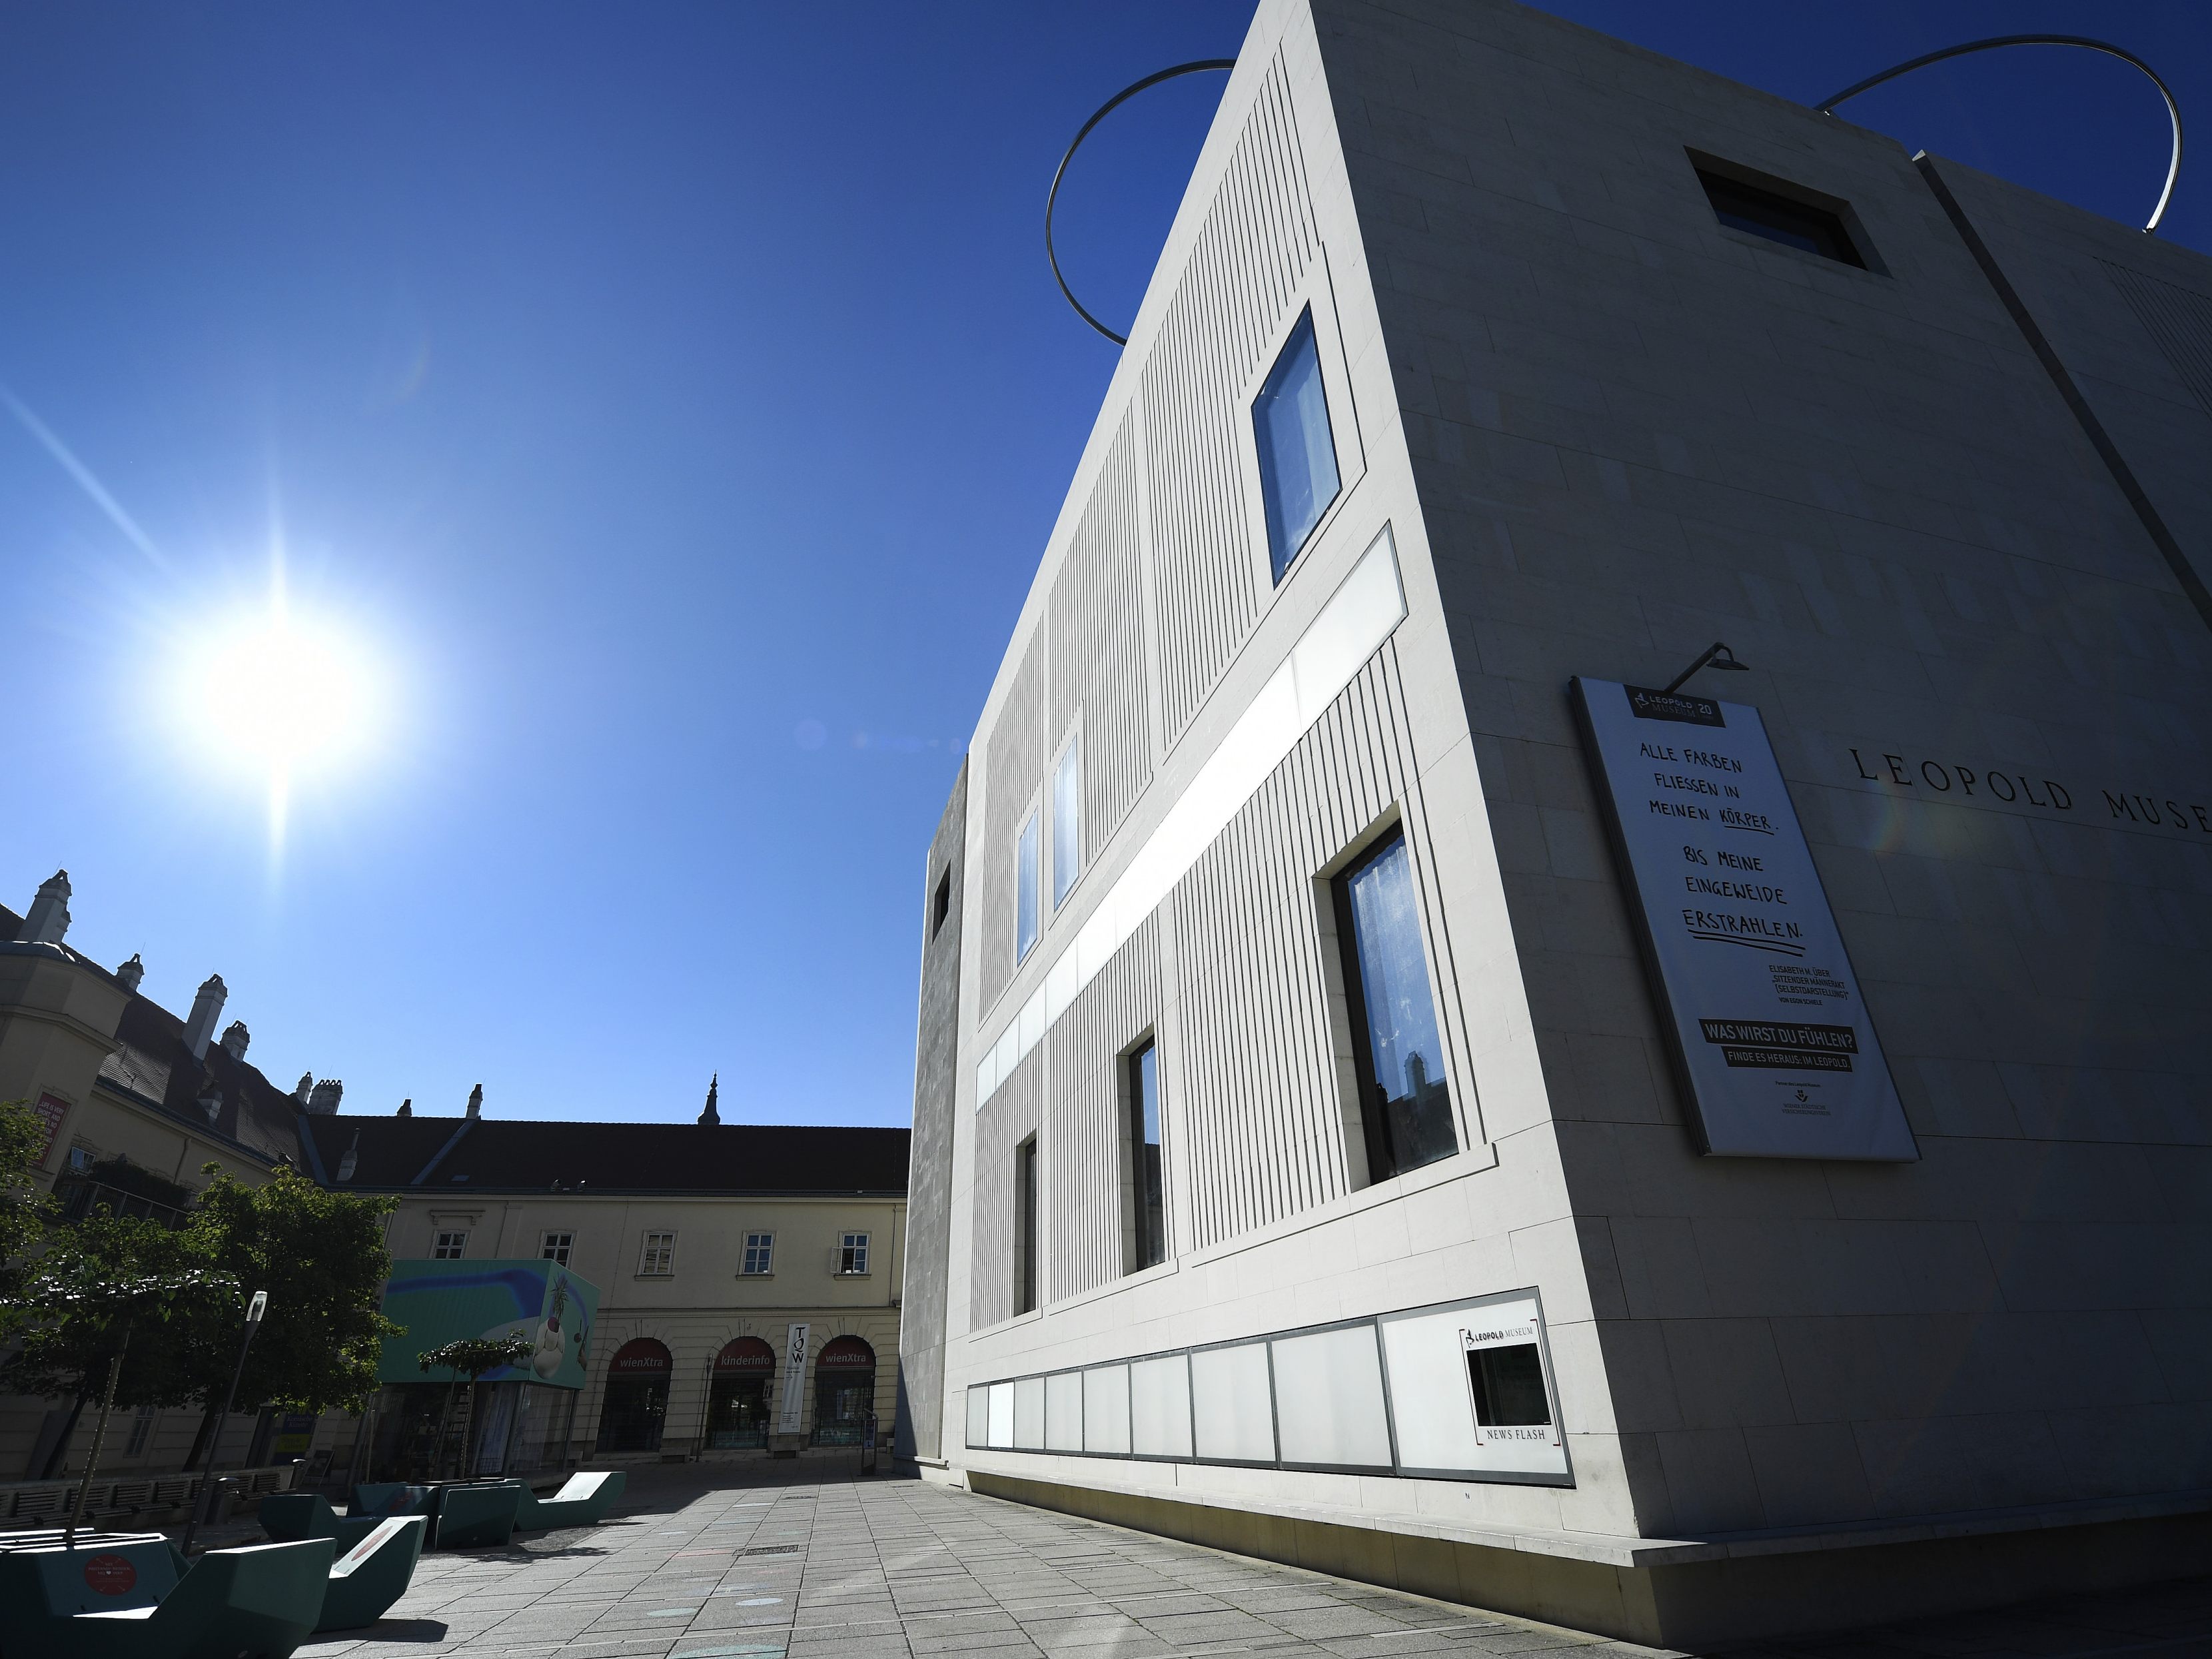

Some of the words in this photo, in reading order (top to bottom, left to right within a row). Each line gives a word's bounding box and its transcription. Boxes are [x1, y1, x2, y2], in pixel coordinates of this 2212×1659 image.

[1649, 695, 1693, 709] LEOPOLD
[1698, 704, 1712, 715] 20
[1651, 703, 1696, 718] MUSEUM
[1640, 742, 1678, 763] ALLE
[1684, 748, 1742, 774] FARBEN
[1654, 772, 1718, 798] FLIESSEN
[1724, 784, 1740, 800] IN
[1848, 748, 2072, 810] LEOPOLD
[1649, 800, 1710, 821] MEINEN
[1683, 845, 1708, 866] BIS
[1718, 851, 1764, 872] MEINE
[1685, 876, 1788, 905] EINGEWEIDE
[1682, 909, 1803, 938] ERSTRAHLEN.
[1769, 965, 1804, 975] ELISABETH
[1813, 967, 1830, 977] ÜBER
[1810, 977, 1845, 989] MÄNNERAKT
[1704, 1023, 1736, 1040] WAS
[1736, 1025, 1776, 1042] WIRST
[1778, 1027, 1797, 1044] DU
[1798, 1027, 1853, 1049] FÜHLEN?
[1728, 1051, 1754, 1061] FINDE
[1756, 1052, 1766, 1062] ES
[1768, 1053, 1802, 1065] HERAUS:
[1803, 1055, 1812, 1065] IM
[1813, 1055, 1851, 1069] LEOPOLD.
[55, 1105, 65, 1115] VERY
[1474, 1331, 1504, 1342] LEOPOLD
[1504, 1327, 1533, 1338] MUSEUM
[620, 1357, 664, 1368] wienXtra
[720, 1355, 770, 1366] kinderinfo
[826, 1353, 867, 1363] wienXtra
[1486, 1429, 1513, 1440] NEWS
[1516, 1429, 1545, 1440] FLASH
